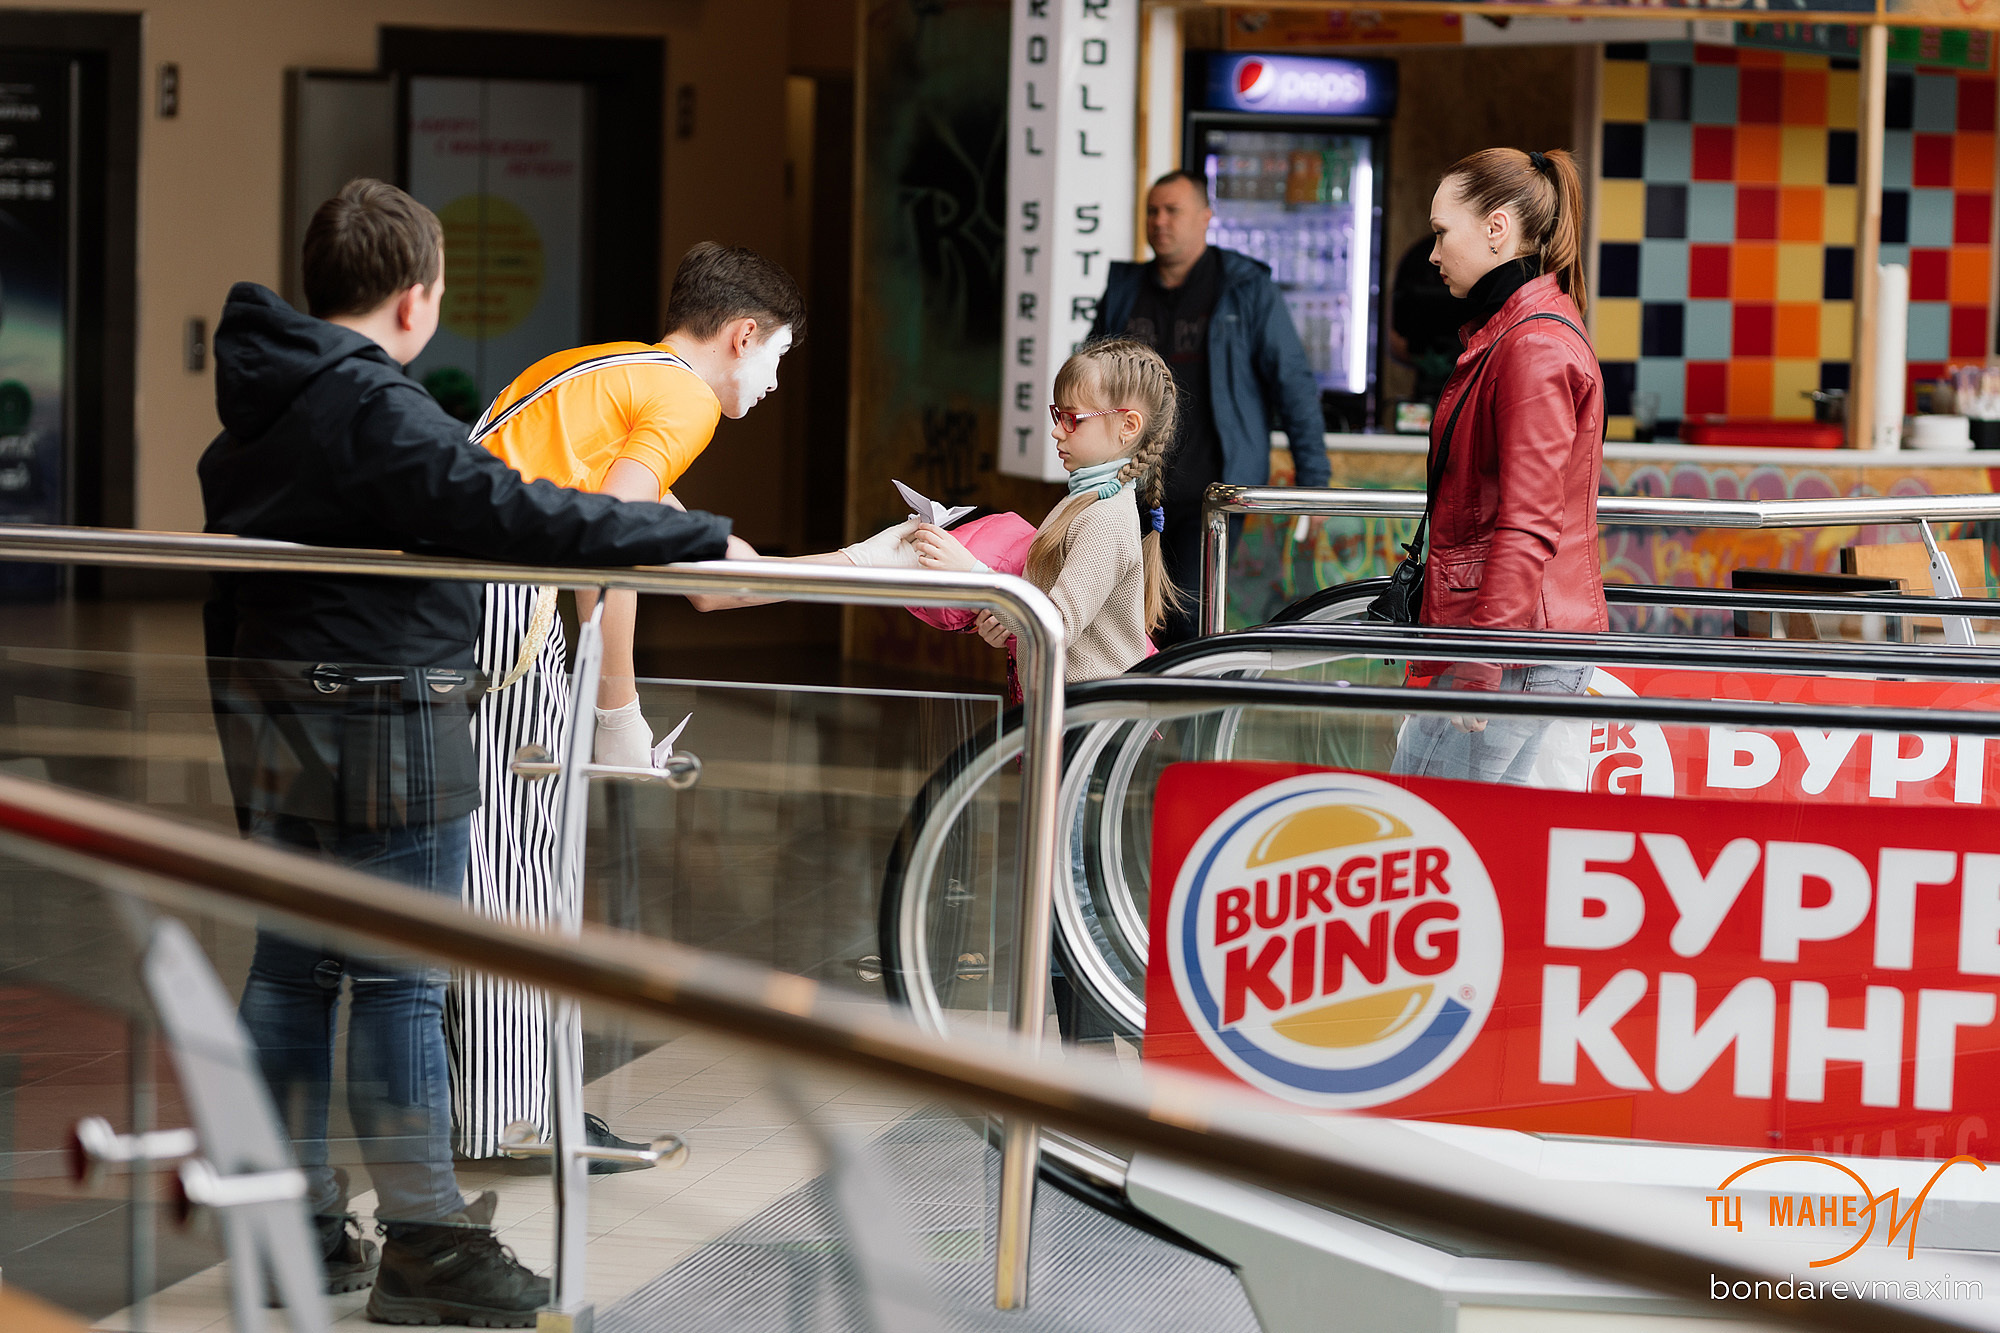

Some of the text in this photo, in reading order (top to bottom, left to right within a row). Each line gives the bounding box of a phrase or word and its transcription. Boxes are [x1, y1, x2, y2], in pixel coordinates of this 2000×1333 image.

[1278, 67, 1367, 108] pepsi
[1014, 0, 1048, 456] ROLL STREET
[1070, 0, 1109, 357] ROLL STR
[1215, 846, 1452, 947] BURGER
[1223, 900, 1460, 1026] KING
[1538, 963, 1998, 1112] КИНГ
